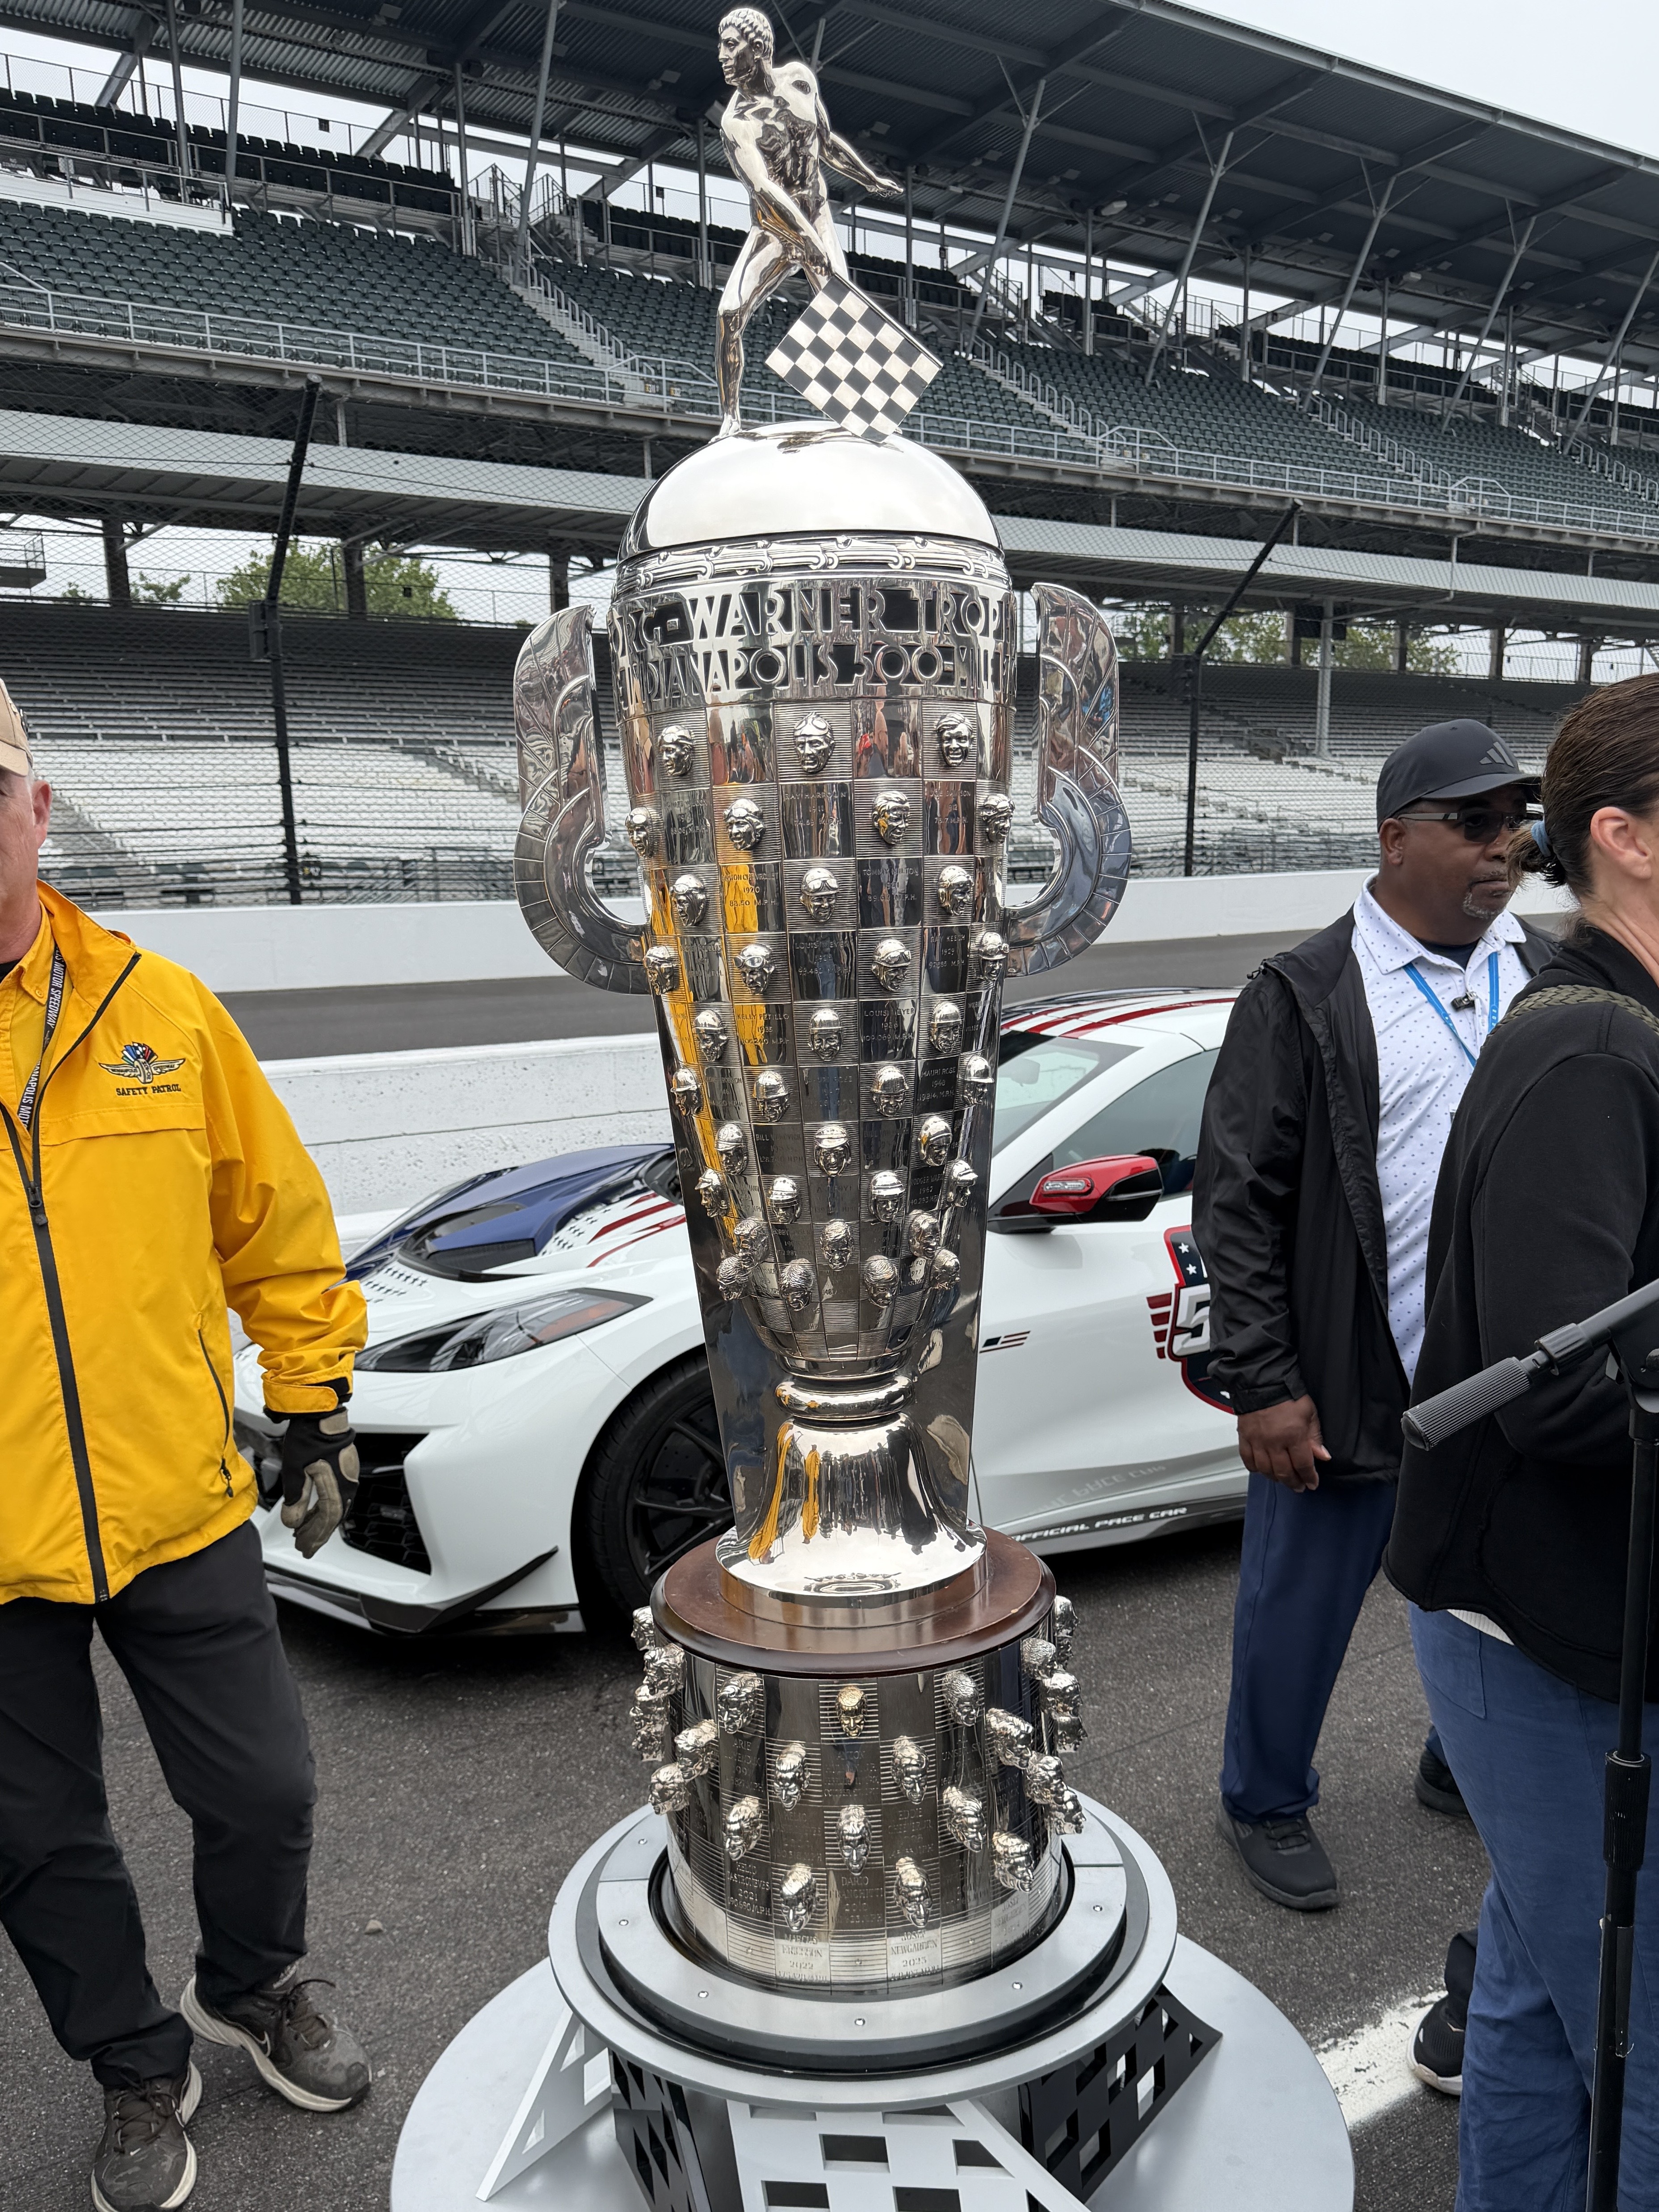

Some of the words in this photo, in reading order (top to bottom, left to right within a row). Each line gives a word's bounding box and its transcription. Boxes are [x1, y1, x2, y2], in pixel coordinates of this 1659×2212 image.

[609, 588, 887, 657] ORG-WARNER
[911, 587, 1011, 641] TROP
[52, 961, 65, 988] MOTOR
[46, 988, 62, 1029] SPEEDWAY
[921, 1068, 941, 1078] MAURI
[942, 1066, 957, 1075] ROSE
[116, 1086, 148, 1096] SAFETY
[151, 1083, 181, 1094] PATROL
[18, 1105, 32, 1129] MOT
[1095, 1513, 1145, 1529] PACE
[1149, 1506, 1188, 1520] CAR
[841, 1876, 869, 1886] DARIO
[738, 1888, 758, 1902] 2021
[790, 1960, 814, 1970] 2022
